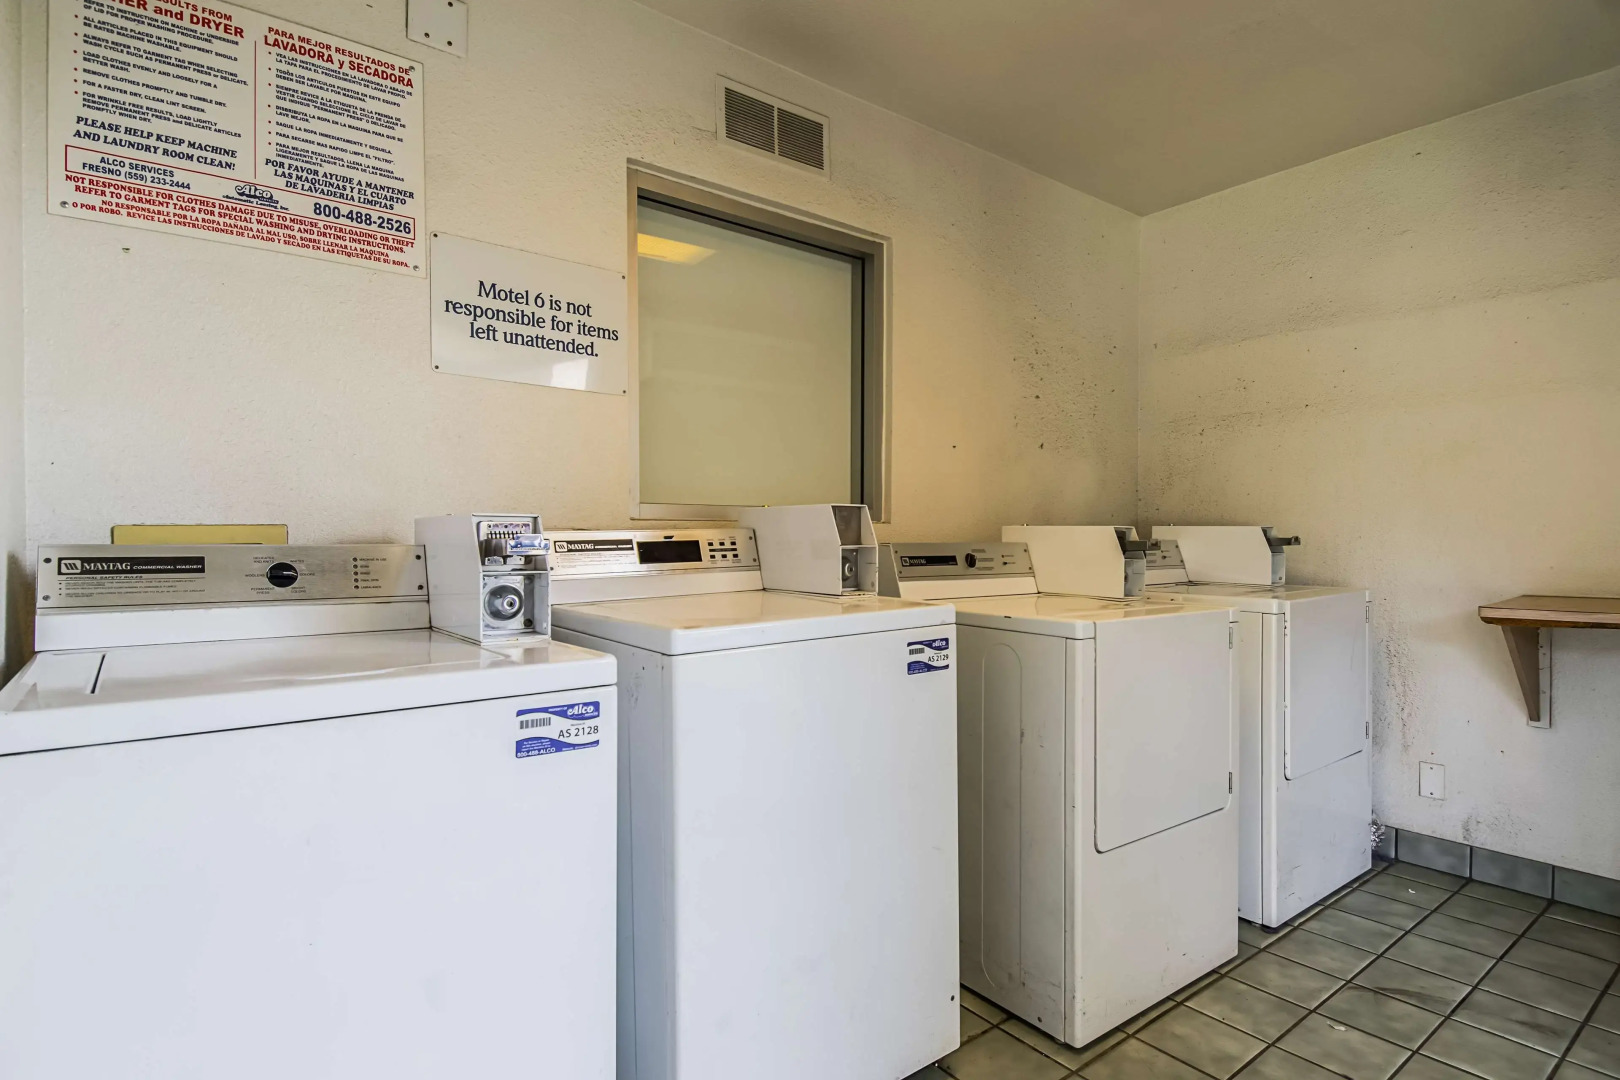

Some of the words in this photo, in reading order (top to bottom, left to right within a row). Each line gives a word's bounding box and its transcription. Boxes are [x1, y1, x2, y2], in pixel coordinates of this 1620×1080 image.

[153, 6, 183, 21] and
[190, 13, 244, 38] DRYER
[202, 7, 232, 22] FROM
[264, 35, 334, 65] LAVADORA
[338, 56, 344, 68] y
[349, 59, 413, 88] SECADORA
[268, 27, 294, 41] PARA
[298, 35, 331, 52] MEJOR
[335, 47, 395, 71] RESULTADOS
[399, 66, 410, 76] DE
[83, 68, 109, 80] REMOVE
[111, 75, 140, 87] CLOTHES
[142, 82, 174, 95] PROMPTLY
[176, 90, 188, 98] AND
[190, 93, 213, 104] TUMBLE
[215, 99, 226, 107] DRY.
[83, 80, 96, 88] FOR
[104, 85, 127, 95] FASTER
[144, 94, 164, 104] CLEAN
[166, 99, 179, 108] LINT
[182, 103, 206, 114] SCREEN.
[83, 92, 95, 100] FOR
[97, 95, 126, 107] WRINKLE
[128, 102, 144, 111] FREE
[176, 112, 191, 121] LOAD
[193, 116, 217, 127] LIGHTLY
[73, 129, 100, 143] AND
[103, 135, 160, 155] LAUNDRY
[162, 148, 194, 162] ROOM
[197, 155, 235, 170] CLEAN!
[76, 115, 121, 134] PLEASE
[124, 126, 153, 140] HELP
[156, 133, 185, 147] KEEP
[187, 139, 237, 158] MACHINE
[83, 162, 121, 177] FRESNO
[125, 170, 147, 182] (559)
[150, 175, 190, 190] 233-2444
[100, 156, 125, 169] ALCO
[129, 162, 174, 178] SERVICES
[265, 158, 285, 170] POR
[288, 163, 319, 178] FAVOR
[322, 171, 354, 186] AYUDE
[356, 179, 362, 188] A
[365, 181, 414, 199] MANTENER
[274, 169, 293, 181] LAS
[295, 173, 347, 192] MAQUINAS
[349, 186, 355, 194] Y
[358, 187, 368, 197] EL
[370, 190, 406, 206] CUARTO
[285, 181, 299, 191] DE
[301, 184, 355, 202] LAVADERIA
[358, 196, 394, 211] LIMPIAS
[65, 174, 86, 186] NOT
[89, 178, 153, 198] RESPONSIBLE
[156, 191, 173, 202] FOR
[176, 195, 216, 210] CLOTHES
[218, 203, 255, 218] DAMAGE
[257, 211, 274, 221] DUE
[276, 215, 287, 224] TO
[289, 217, 321, 230] MISUSE,
[323, 224, 378, 241] OVERLOADING
[380, 234, 390, 244] OR
[391, 237, 414, 248] THEFT
[75, 185, 106, 198] REFER
[109, 191, 122, 201] TO
[124, 194, 170, 210] GARMENT
[172, 203, 196, 215] TAGS
[198, 208, 215, 218] FOR
[218, 212, 254, 225] SPECIAL
[256, 219, 295, 233] WASHING
[297, 227, 314, 237] AND
[317, 231, 347, 243] DRYING
[349, 237, 405, 254] INSTRUCTIONS.
[102, 199, 113, 208] NO
[115, 202, 171, 218] RESPONSABLE
[173, 212, 188, 221] POR
[190, 215, 199, 224] LA
[202, 218, 221, 227] ROPA
[267, 230, 281, 238] MAL
[283, 233, 298, 241] USO,
[300, 236, 321, 245] SOBRE
[323, 240, 348, 250] LLENAR
[360, 247, 389, 258] MAQUINA
[314, 202, 411, 234] 800-488-2526
[72, 201, 78, 209] O
[80, 203, 96, 212] POR
[99, 206, 122, 217] ROBO.
[127, 211, 155, 223] REVICE
[158, 217, 172, 226] LAS
[174, 220, 234, 237] INSTRUCCIONES
[236, 231, 245, 239] DE
[247, 233, 275, 244] LAVADO
[283, 239, 310, 250] SECADO
[312, 244, 321, 252] EN
[323, 246, 335, 254] LAS
[337, 249, 372, 261] ETIQUETAS
[373, 255, 381, 263] DE
[392, 259, 410, 267] ROPA.
[477, 280, 529, 306] Motel
[534, 292, 545, 308] 6
[549, 295, 561, 312] is
[566, 302, 592, 317] not
[444, 300, 546, 328] responsible
[551, 316, 573, 333] for
[577, 320, 618, 341] items
[470, 322, 498, 341] left
[503, 332, 599, 357] unattended.
[83, 562, 130, 570] MAYTAG
[567, 704, 594, 715] Alco
[558, 729, 571, 739] AS
[574, 725, 599, 737] 2128
